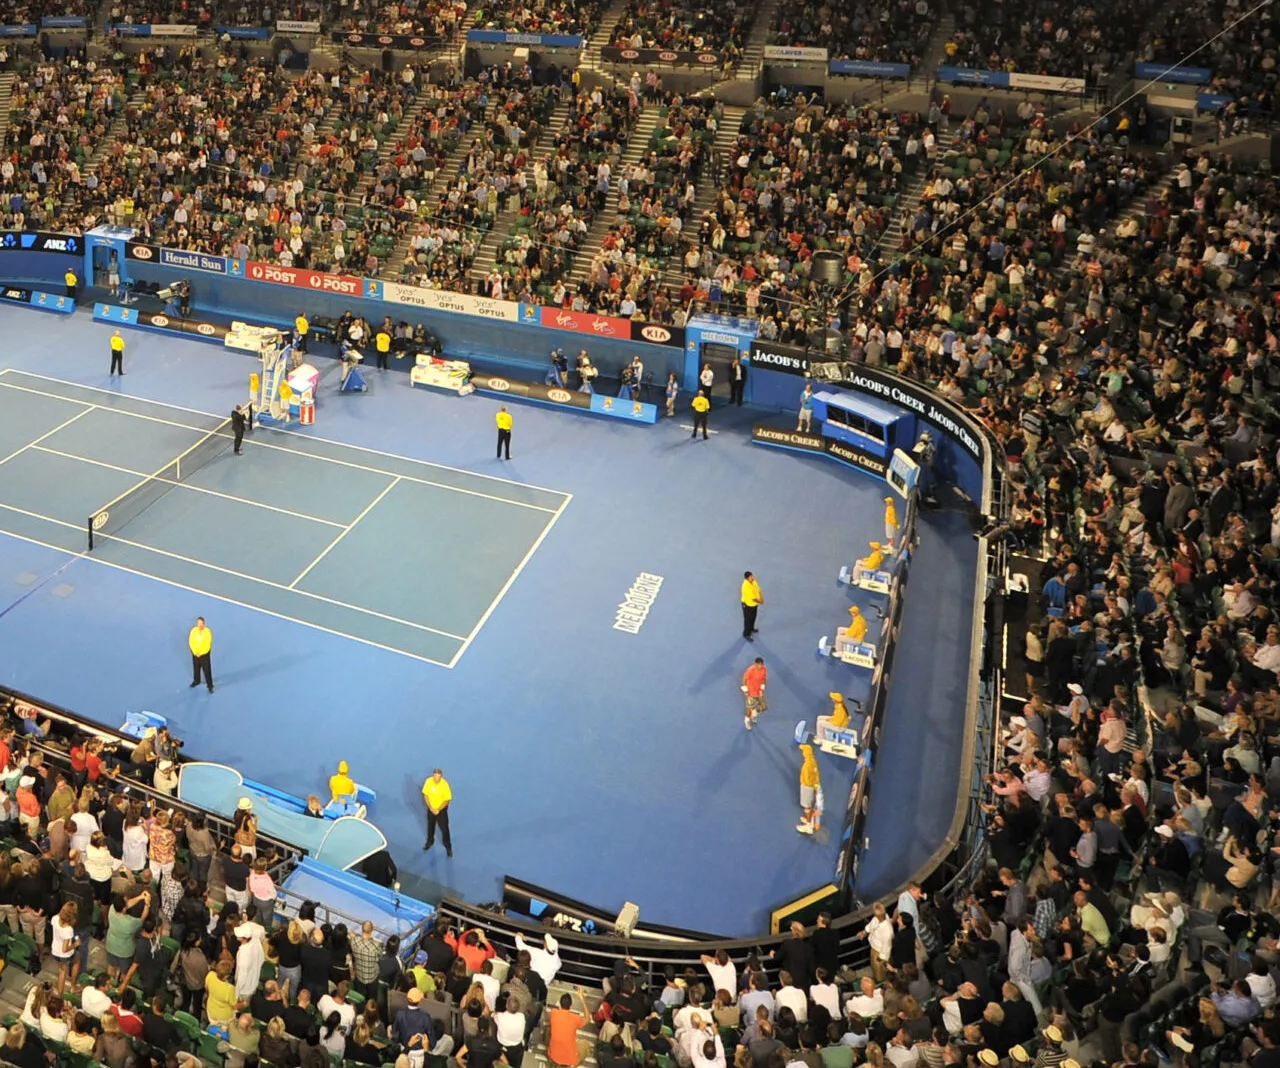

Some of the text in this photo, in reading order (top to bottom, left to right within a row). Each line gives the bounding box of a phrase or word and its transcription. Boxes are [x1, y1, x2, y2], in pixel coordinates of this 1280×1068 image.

[44, 239, 66, 250] ANZ
[135, 248, 150, 257] KIA
[165, 252, 222, 270] Herald Sun
[266, 270, 296, 284] POST
[324, 278, 356, 293] POST
[6, 290, 21, 298] ANZ
[400, 296, 425, 305] OPTUS
[439, 302, 464, 311] OPTUS
[478, 308, 505, 317] OPTUS
[646, 329, 667, 339] KIA
[753, 350, 800, 368] JACOB'S
[490, 380, 506, 388] KIA
[551, 390, 568, 400] KIA
[847, 372, 926, 413] JACOB'S CREEK
[928, 406, 979, 456] JACOB'S CREEK
[756, 428, 820, 447] JACOB'S CREEK
[829, 444, 858, 461] JACOB'S
[858, 455, 884, 472] CREEK
[616, 573, 662, 632] MELBOURNE
[844, 655, 870, 664] LACOSTE
